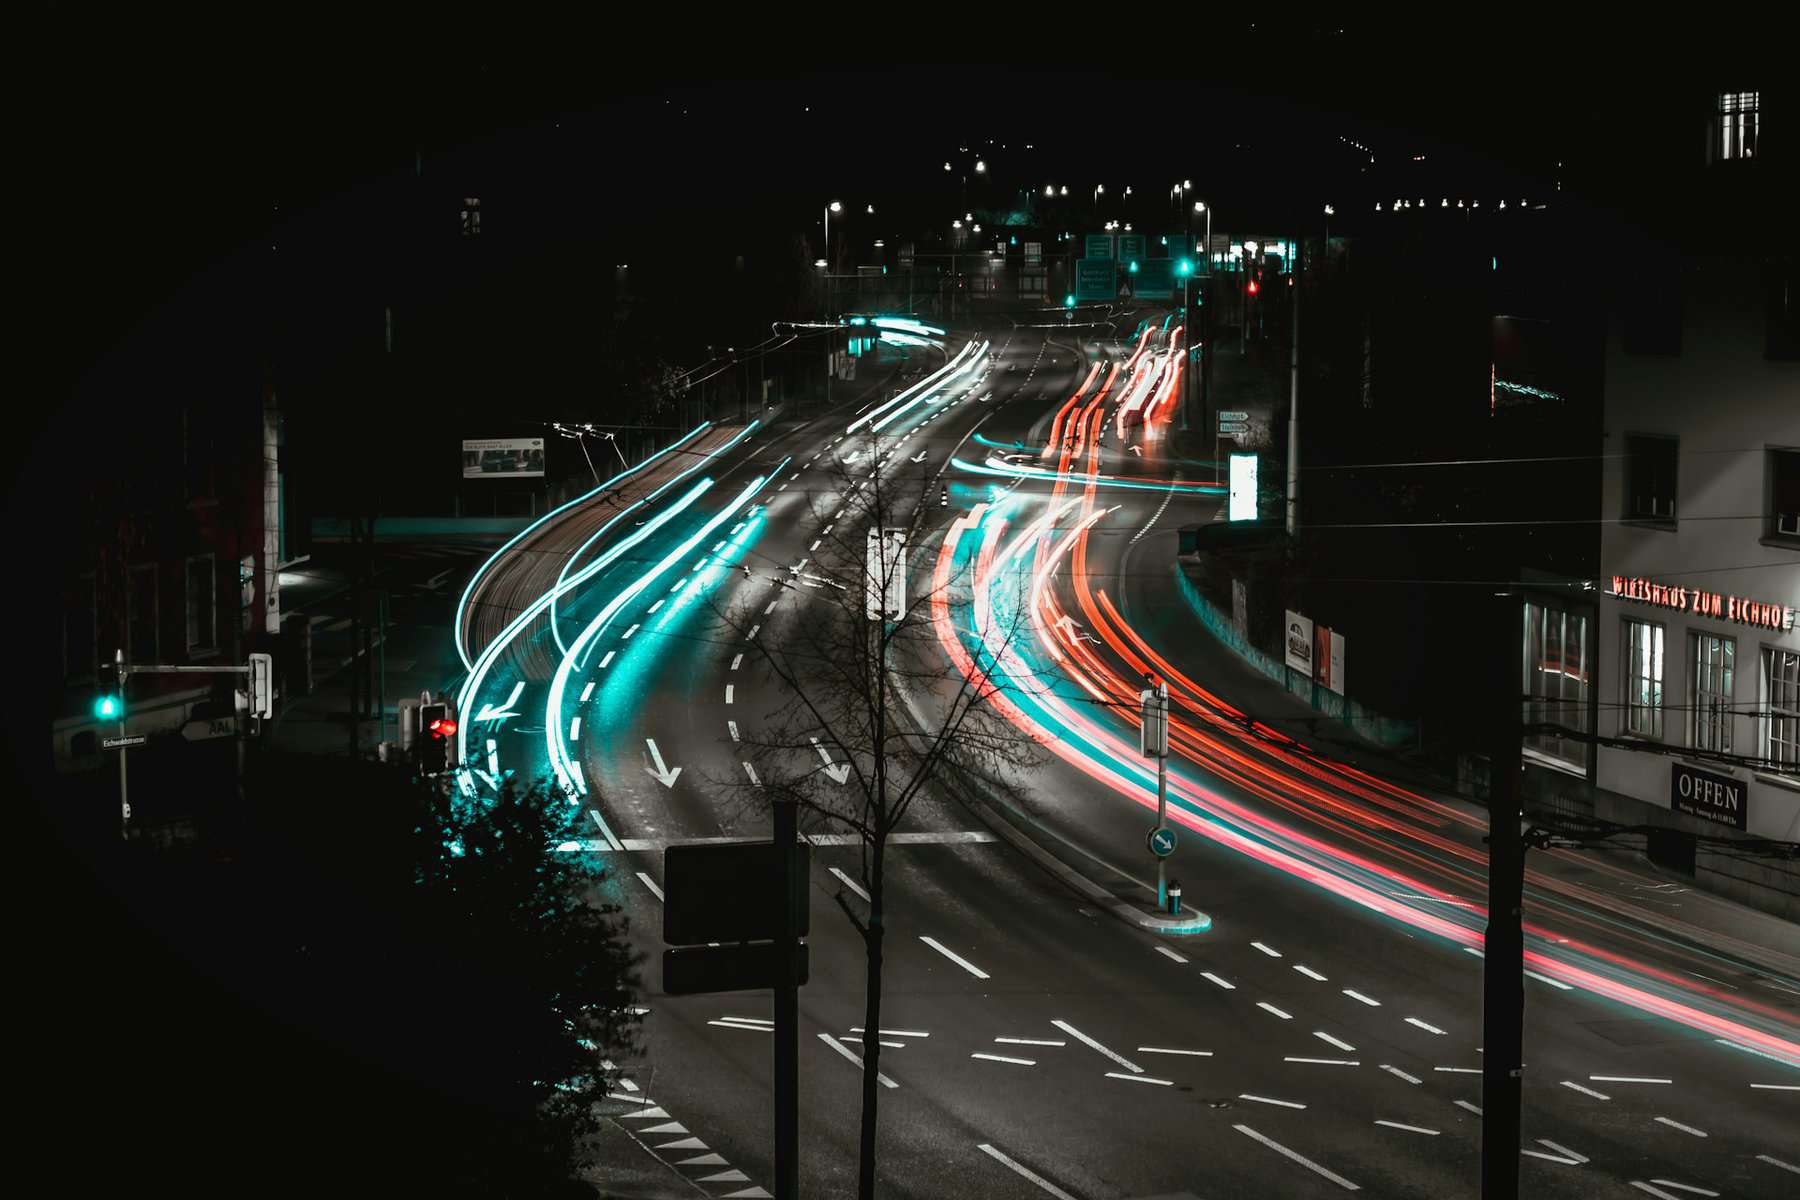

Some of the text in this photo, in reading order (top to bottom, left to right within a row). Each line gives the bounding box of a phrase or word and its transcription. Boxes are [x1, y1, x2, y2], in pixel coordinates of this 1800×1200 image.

[1612, 575, 1687, 609] WIRTSHAUS
[1693, 590, 1722, 616] ZUM
[1679, 773, 1739, 811] OFFEN
